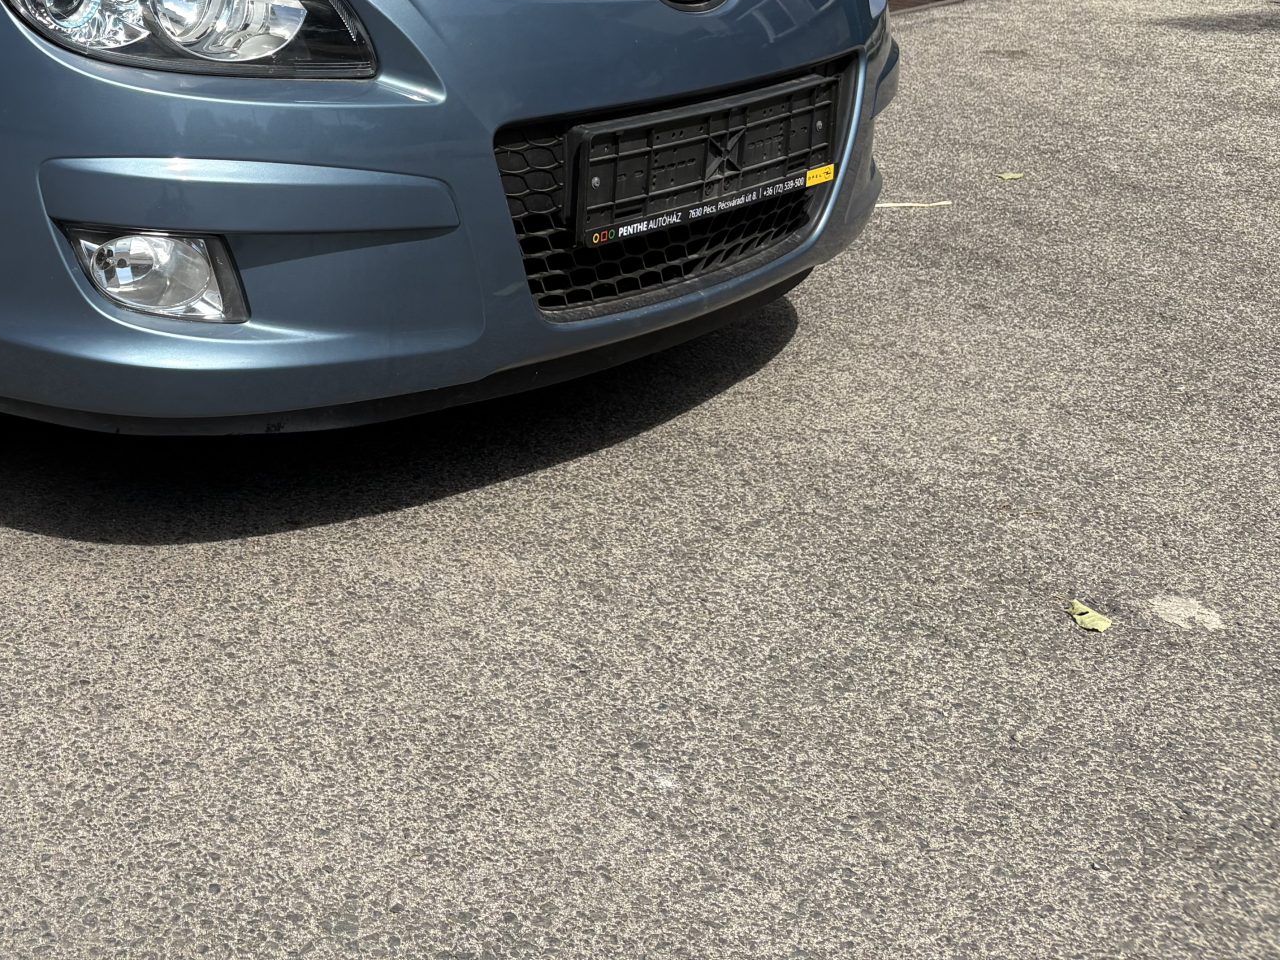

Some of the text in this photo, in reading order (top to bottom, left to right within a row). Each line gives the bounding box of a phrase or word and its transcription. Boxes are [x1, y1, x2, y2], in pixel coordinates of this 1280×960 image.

[617, 221, 649, 238] PENTHE
[648, 211, 682, 229] AUTÓHÁZ
[688, 208, 703, 219] 7630
[717, 195, 746, 211] Pécsváradi
[763, 186, 773, 197] +36
[773, 183, 784, 195] (72)
